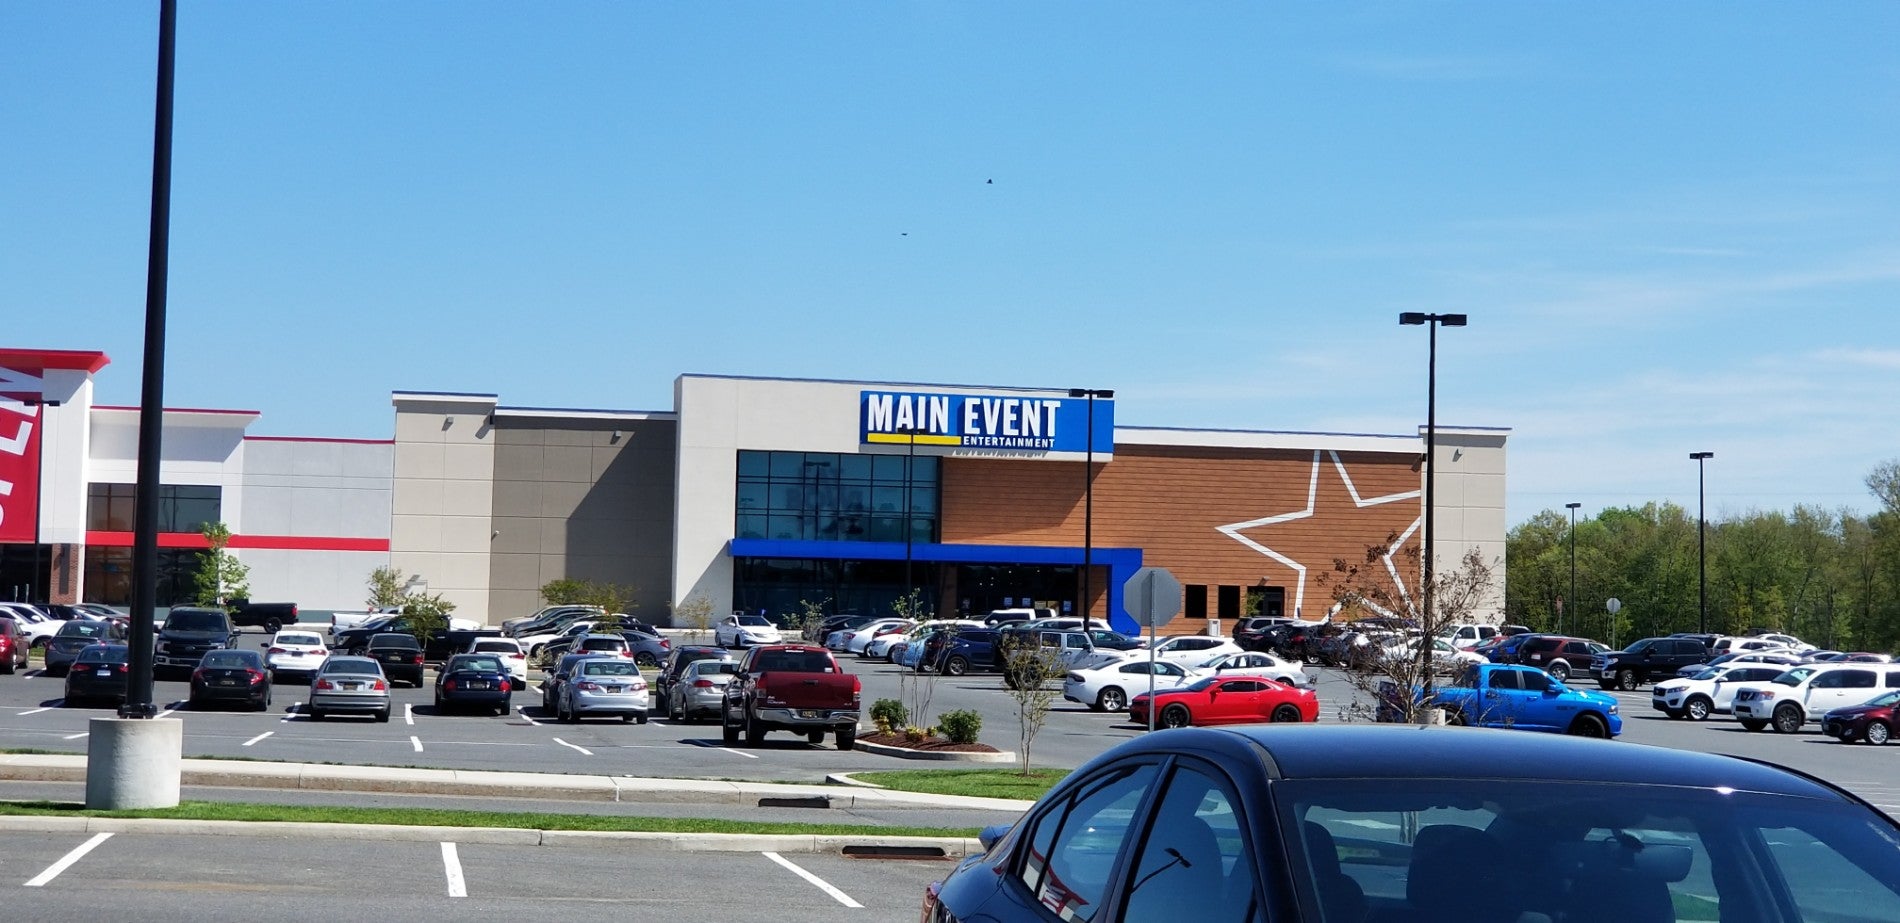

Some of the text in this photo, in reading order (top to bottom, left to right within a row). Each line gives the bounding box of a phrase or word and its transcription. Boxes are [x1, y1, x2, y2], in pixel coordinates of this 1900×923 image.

[867, 394, 1061, 437] MAIN EVENT
[963, 436, 1055, 448] ENTERTAINMENT
